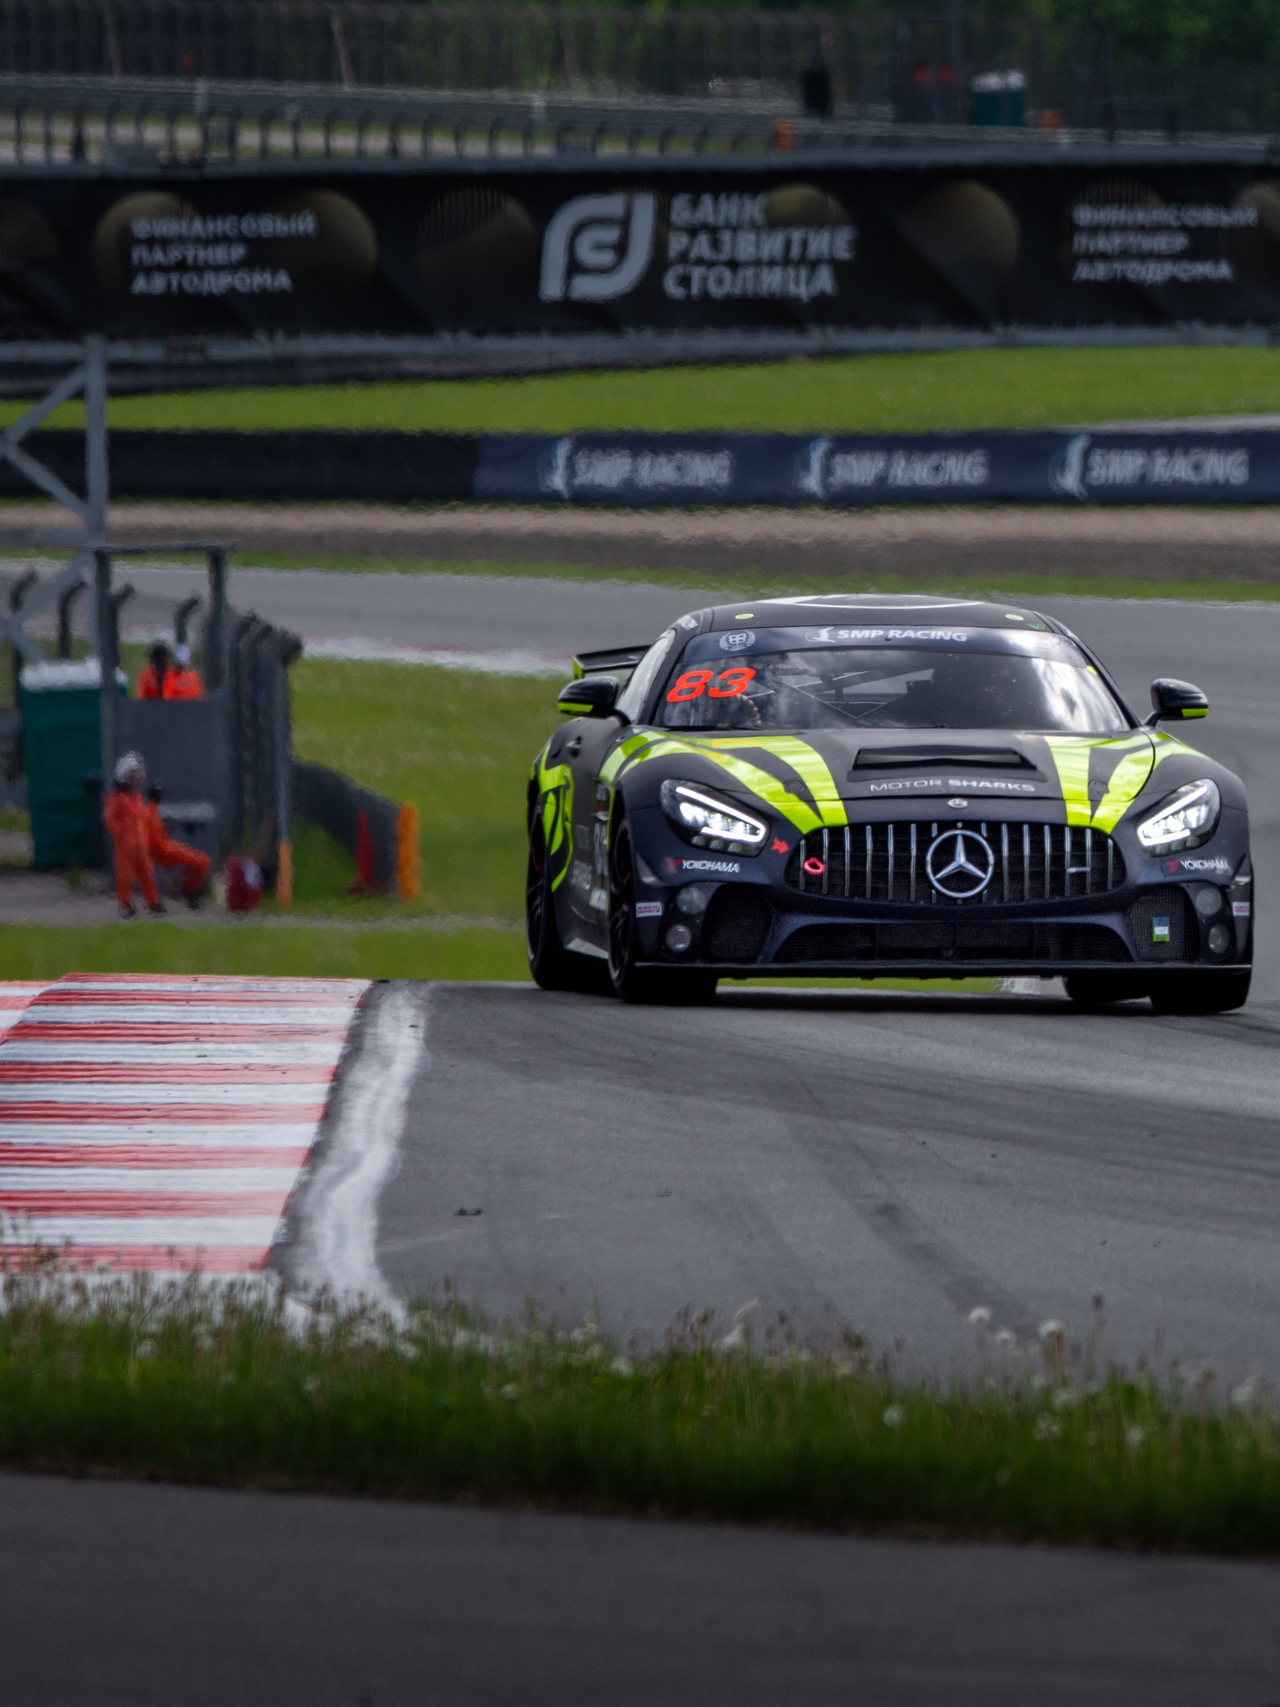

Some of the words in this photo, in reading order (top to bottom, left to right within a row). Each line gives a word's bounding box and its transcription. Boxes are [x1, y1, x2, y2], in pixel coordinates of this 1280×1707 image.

[670, 191, 768, 227] БАНК
[667, 226, 857, 263] РАЗВИТИЕ
[130, 268, 293, 296] АВТОДРОМА
[662, 264, 837, 303] СТОЛИЦА
[836, 629, 884, 640] SMP
[886, 629, 967, 642] RACING
[667, 668, 756, 703] 83
[870, 780, 941, 791] MOTOR
[947, 778, 1036, 792] SHARKS
[682, 860, 740, 873] YOKOHAMA
[1181, 858, 1231, 870] YOKOHAMA
